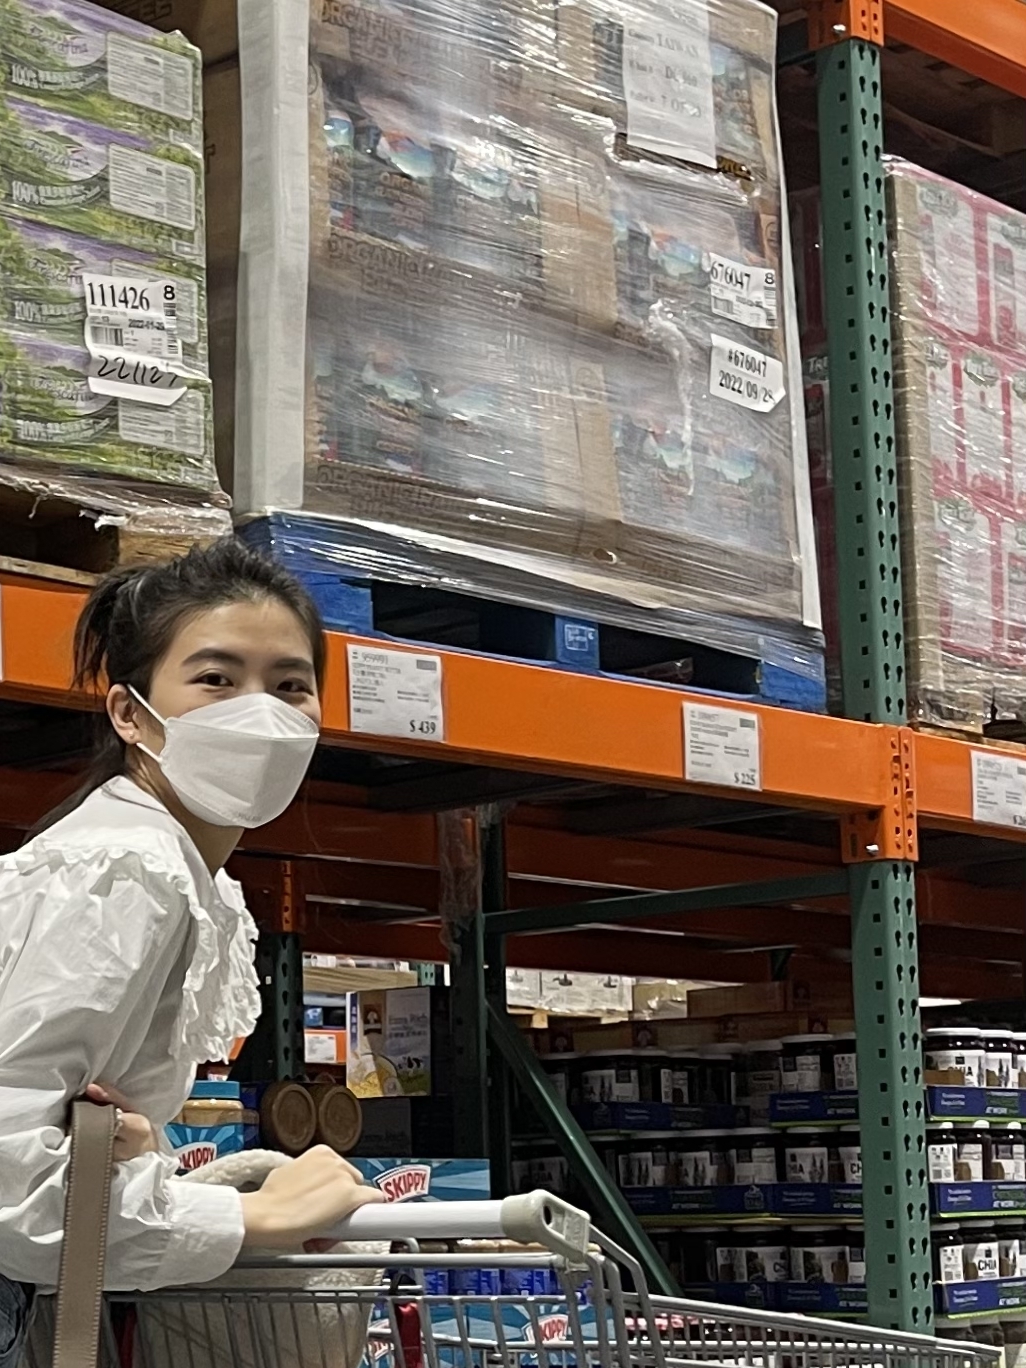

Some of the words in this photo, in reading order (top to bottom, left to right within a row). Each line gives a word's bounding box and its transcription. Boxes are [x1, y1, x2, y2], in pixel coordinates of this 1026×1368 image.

[710, 261, 751, 291] 676047
[764, 272, 775, 285] 8
[85, 281, 151, 313] 111426
[163, 284, 175, 300] 8
[418, 720, 437, 735] 439
[384, 1170, 427, 1203] SKIPPY
[978, 1259, 997, 1271] CHIA
